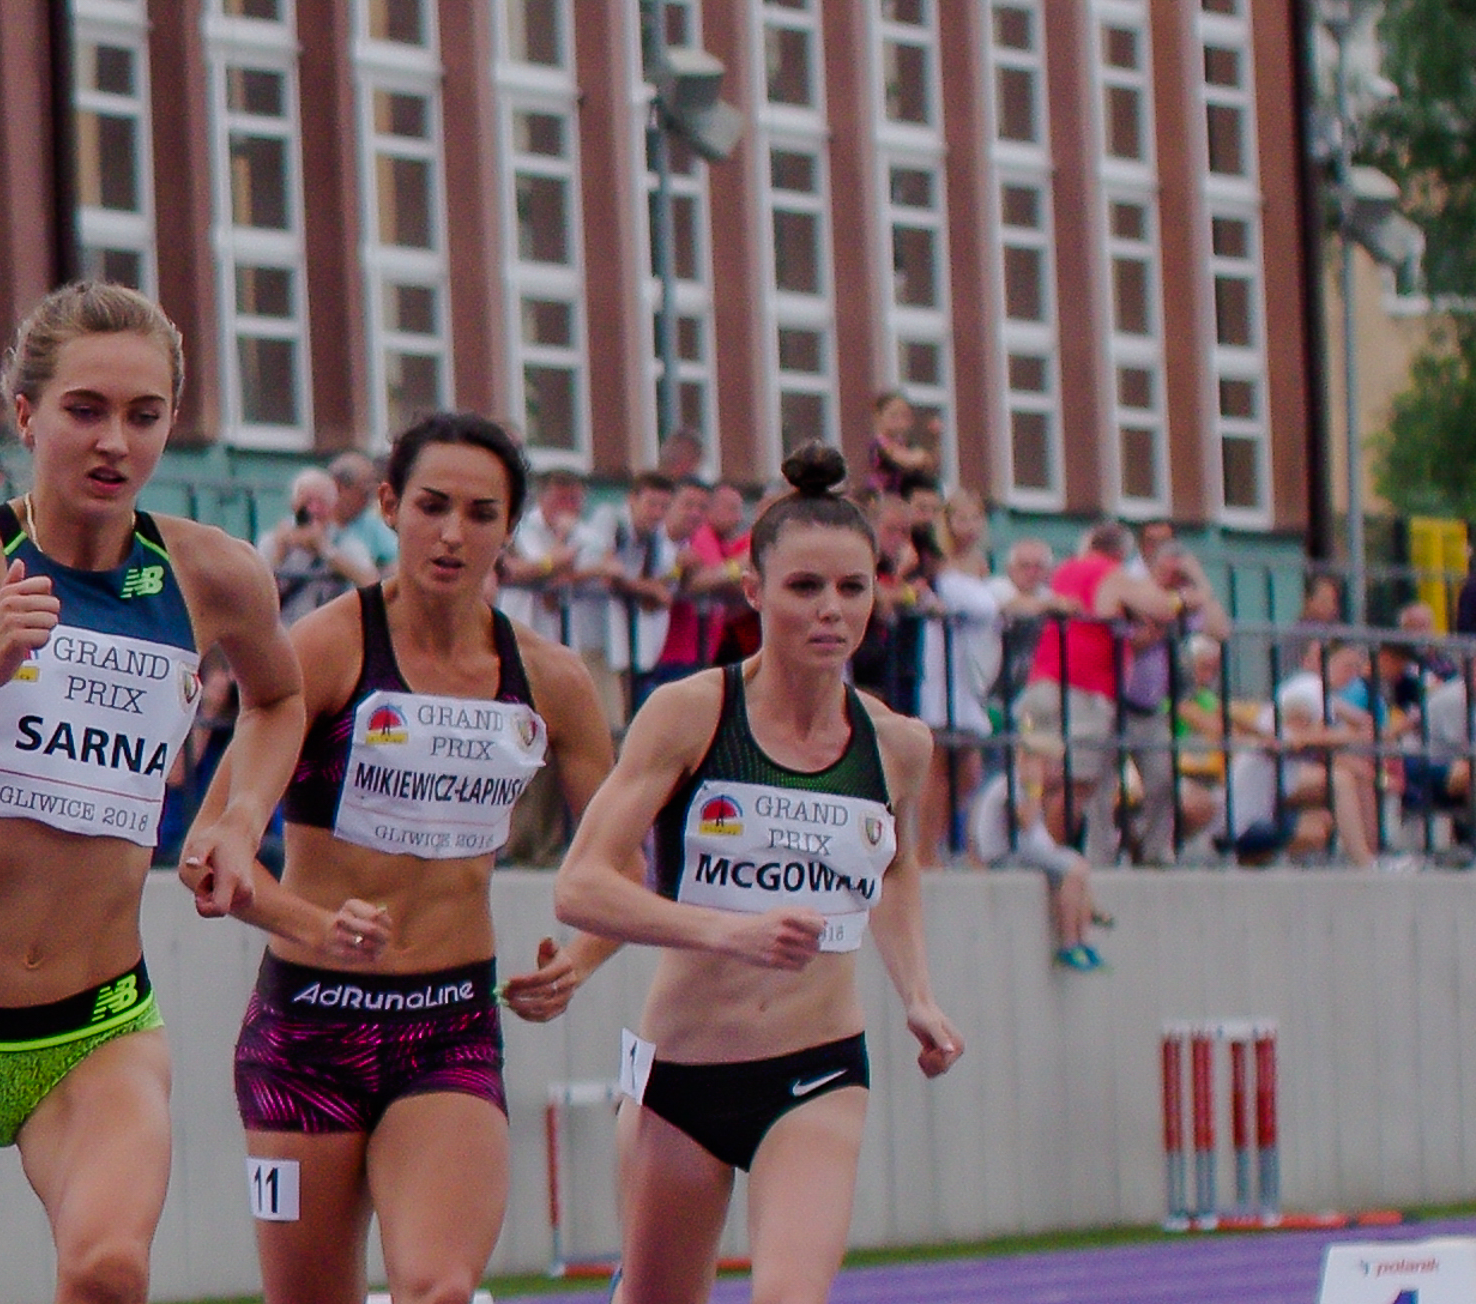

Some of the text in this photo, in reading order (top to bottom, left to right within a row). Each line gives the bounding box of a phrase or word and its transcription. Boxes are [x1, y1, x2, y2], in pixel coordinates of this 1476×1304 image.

[53, 636, 170, 680] GRAND
[64, 676, 147, 714] PRIX
[14, 714, 168, 778] SARNA
[430, 736, 495, 760] PRIX
[0, 785, 149, 832] GLIWICE 2018
[755, 795, 849, 827] GRAND
[254, 1166, 278, 1214] 11
